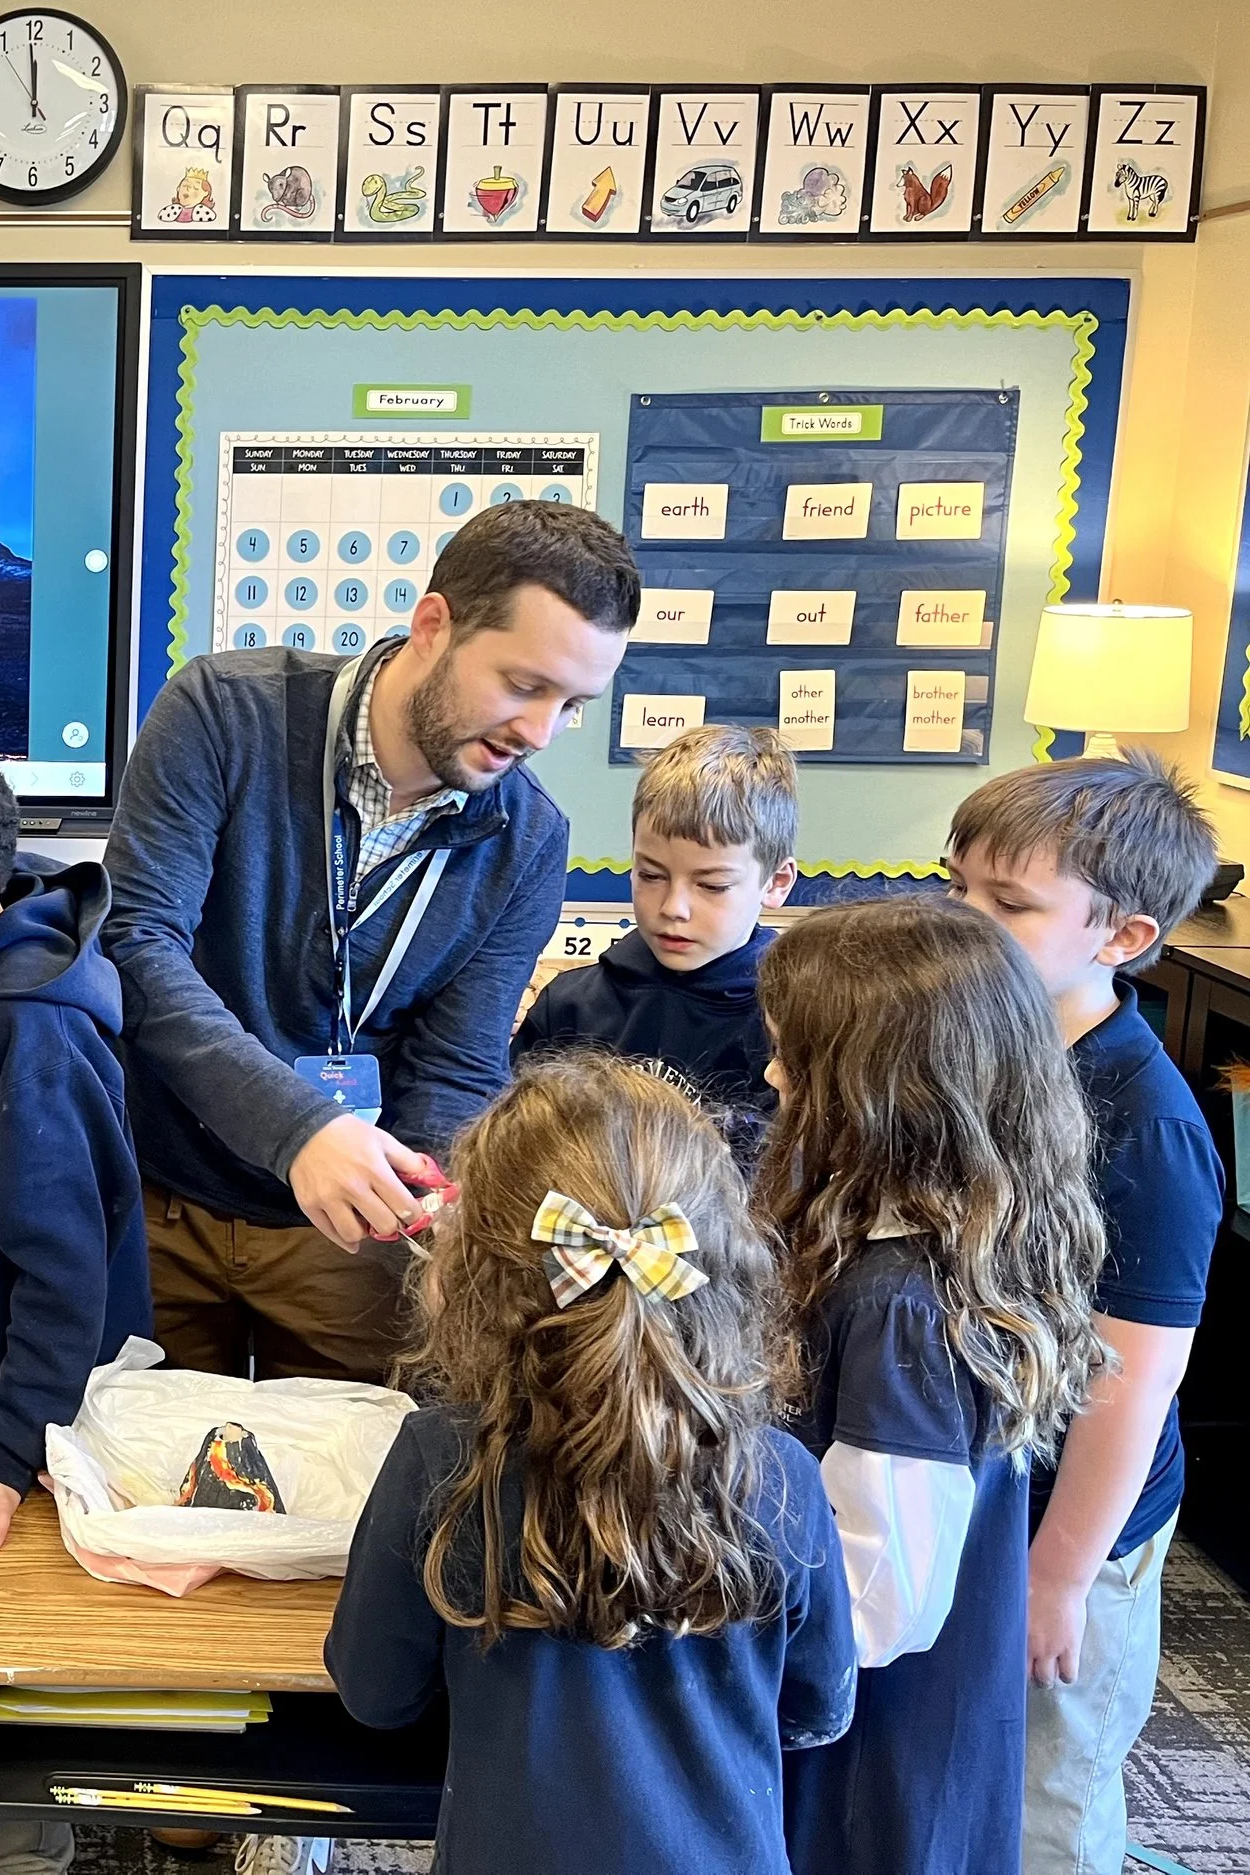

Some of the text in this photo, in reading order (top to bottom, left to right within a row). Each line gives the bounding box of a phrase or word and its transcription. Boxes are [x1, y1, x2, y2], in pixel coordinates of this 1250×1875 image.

[26, 20, 43, 41] 12
[66, 30, 73, 51] 1
[91, 56, 101, 76] 2
[99, 93, 109, 113] 3
[265, 103, 307, 147] Rr
[368, 103, 426, 146] Ss
[473, 103, 517, 146] Tt
[574, 102, 634, 147] Uu
[677, 102, 740, 146] Vv
[789, 102, 854, 148] Ww
[896, 101, 961, 145] Xx
[1009, 104, 1070, 158] Yy
[1118, 101, 1175, 145] Zz
[88, 129, 98, 149] 4
[161, 104, 222, 164] Qq
[65, 156, 74, 176] 5
[28, 167, 38, 186] 6
[1017, 187, 1040, 209] YELLOW
[379, 394, 445, 408] February
[789, 417, 852, 429] Trick Words
[244, 449, 577, 460] SUNDAY MONDAY TUESDAY WEDNESDAY THURSDAY FRIDAY SATURDAY
[250, 463, 565, 473] SUN MON TUES WED THU FRI SAT
[454, 491, 458, 507] 1
[661, 497, 709, 517] earth
[802, 496, 854, 518] friend
[910, 496, 972, 526] picture
[249, 537, 408, 555] 4 5 6 7
[247, 585, 407, 603] 11 12 13 14
[656, 608, 685, 622] our
[796, 604, 827, 624] out
[915, 603, 970, 623] father
[244, 631, 359, 647] 18 19 20
[791, 687, 824, 700] other
[913, 685, 959, 699] brother
[642, 707, 686, 727] learn
[783, 712, 830, 725] another
[912, 710, 956, 725] mother
[334, 835, 345, 910] Perimeter School
[565, 937, 592, 956] 52
[320, 1071, 344, 1080] Quick
